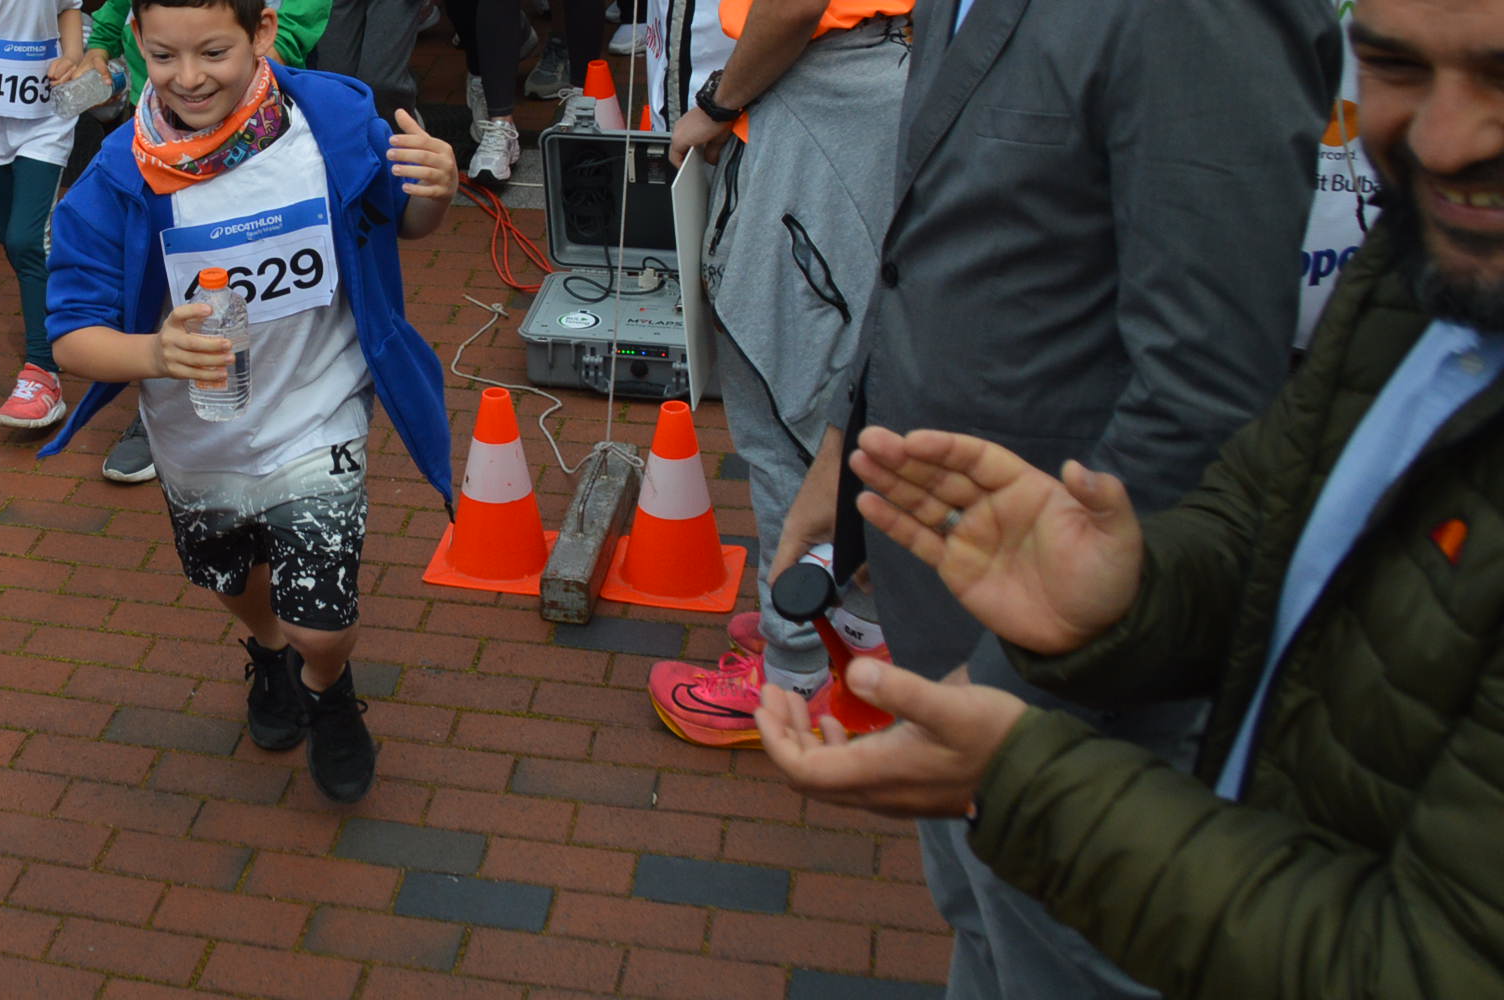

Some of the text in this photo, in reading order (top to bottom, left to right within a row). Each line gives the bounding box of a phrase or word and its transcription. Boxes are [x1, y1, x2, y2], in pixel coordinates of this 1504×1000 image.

[224, 214, 283, 236] DECATHLON
[329, 441, 361, 475] K
[844, 624, 864, 640] CAT
